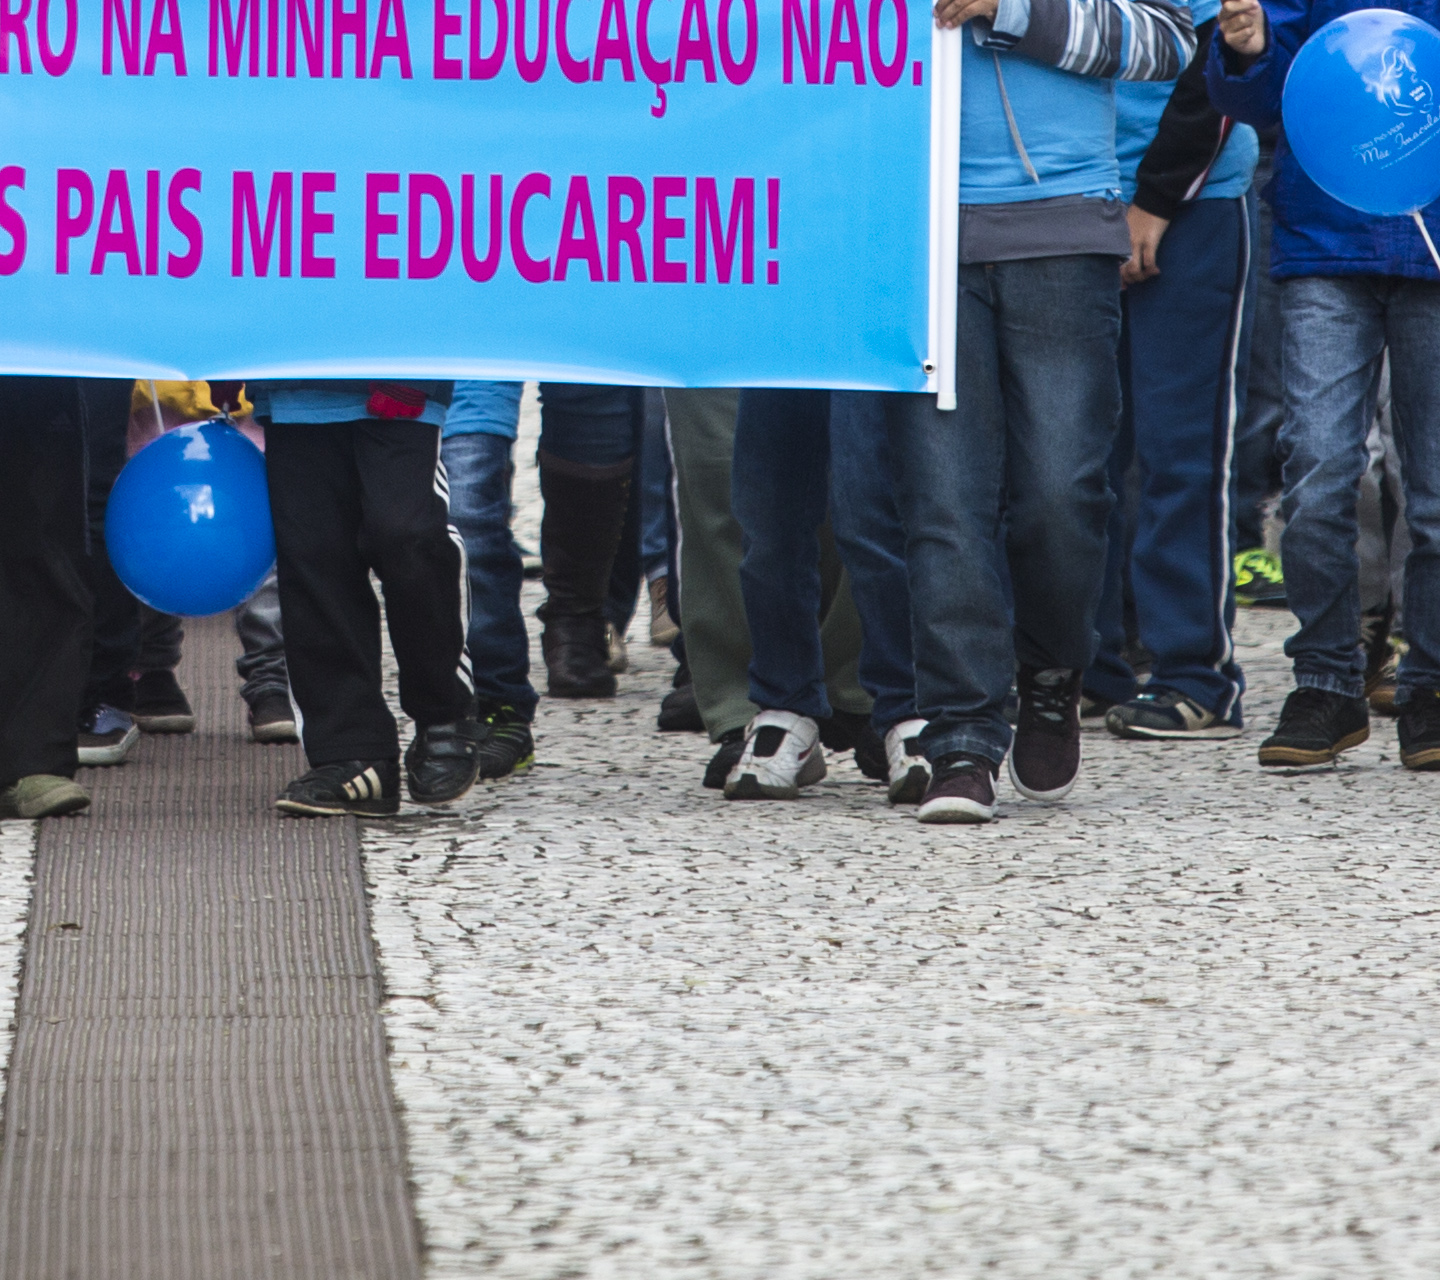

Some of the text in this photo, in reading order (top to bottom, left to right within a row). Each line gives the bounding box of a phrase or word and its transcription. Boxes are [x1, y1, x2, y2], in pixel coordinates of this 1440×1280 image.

[55, 168, 203, 280] PAIS
[231, 170, 336, 279] ME
[364, 172, 781, 286] EDUCAREM!
